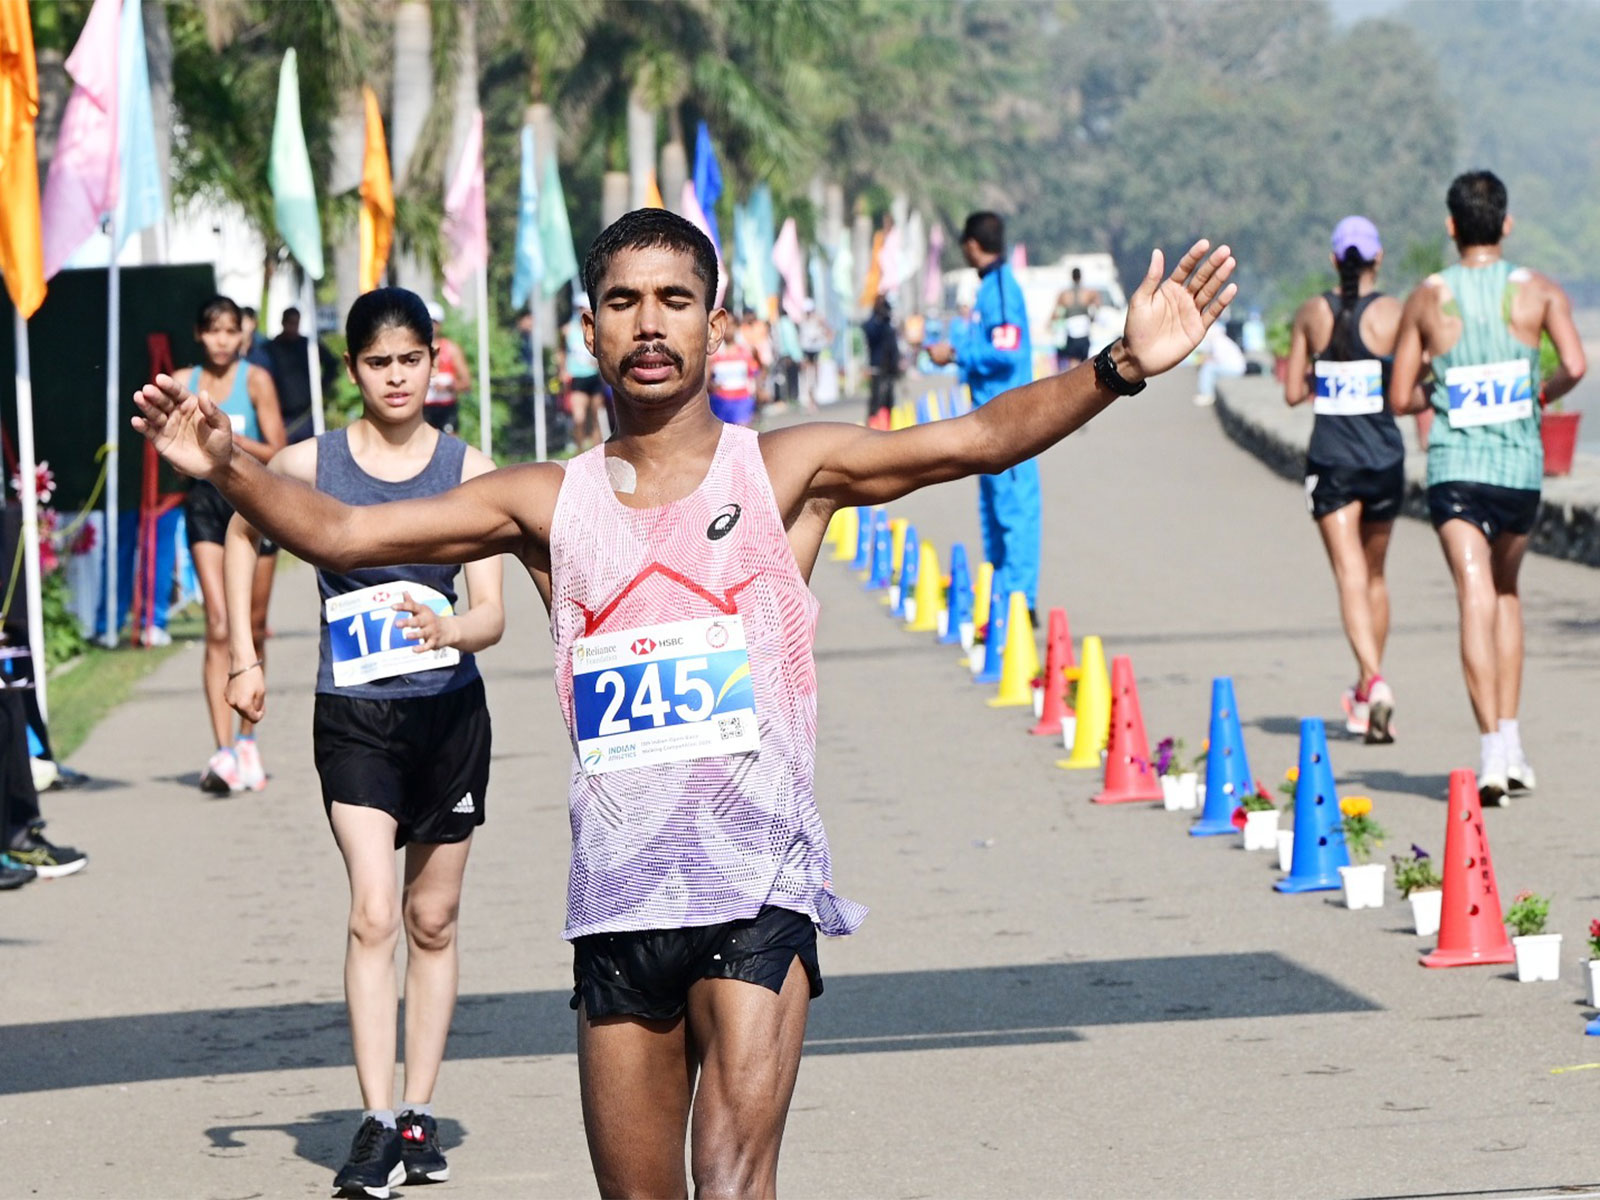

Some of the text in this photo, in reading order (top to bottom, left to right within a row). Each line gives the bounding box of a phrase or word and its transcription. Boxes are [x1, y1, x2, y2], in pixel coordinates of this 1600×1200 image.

[1325, 375, 1368, 399] 129
[1459, 378, 1515, 408] 217
[658, 637, 684, 648] HSBC
[585, 644, 617, 657] Reliance
[595, 658, 715, 736] 245
[668, 736, 684, 744] Open
[608, 743, 636, 754] INDIAN
[608, 751, 637, 761] ATHLETICS
[1475, 824, 1492, 894] Vinex
